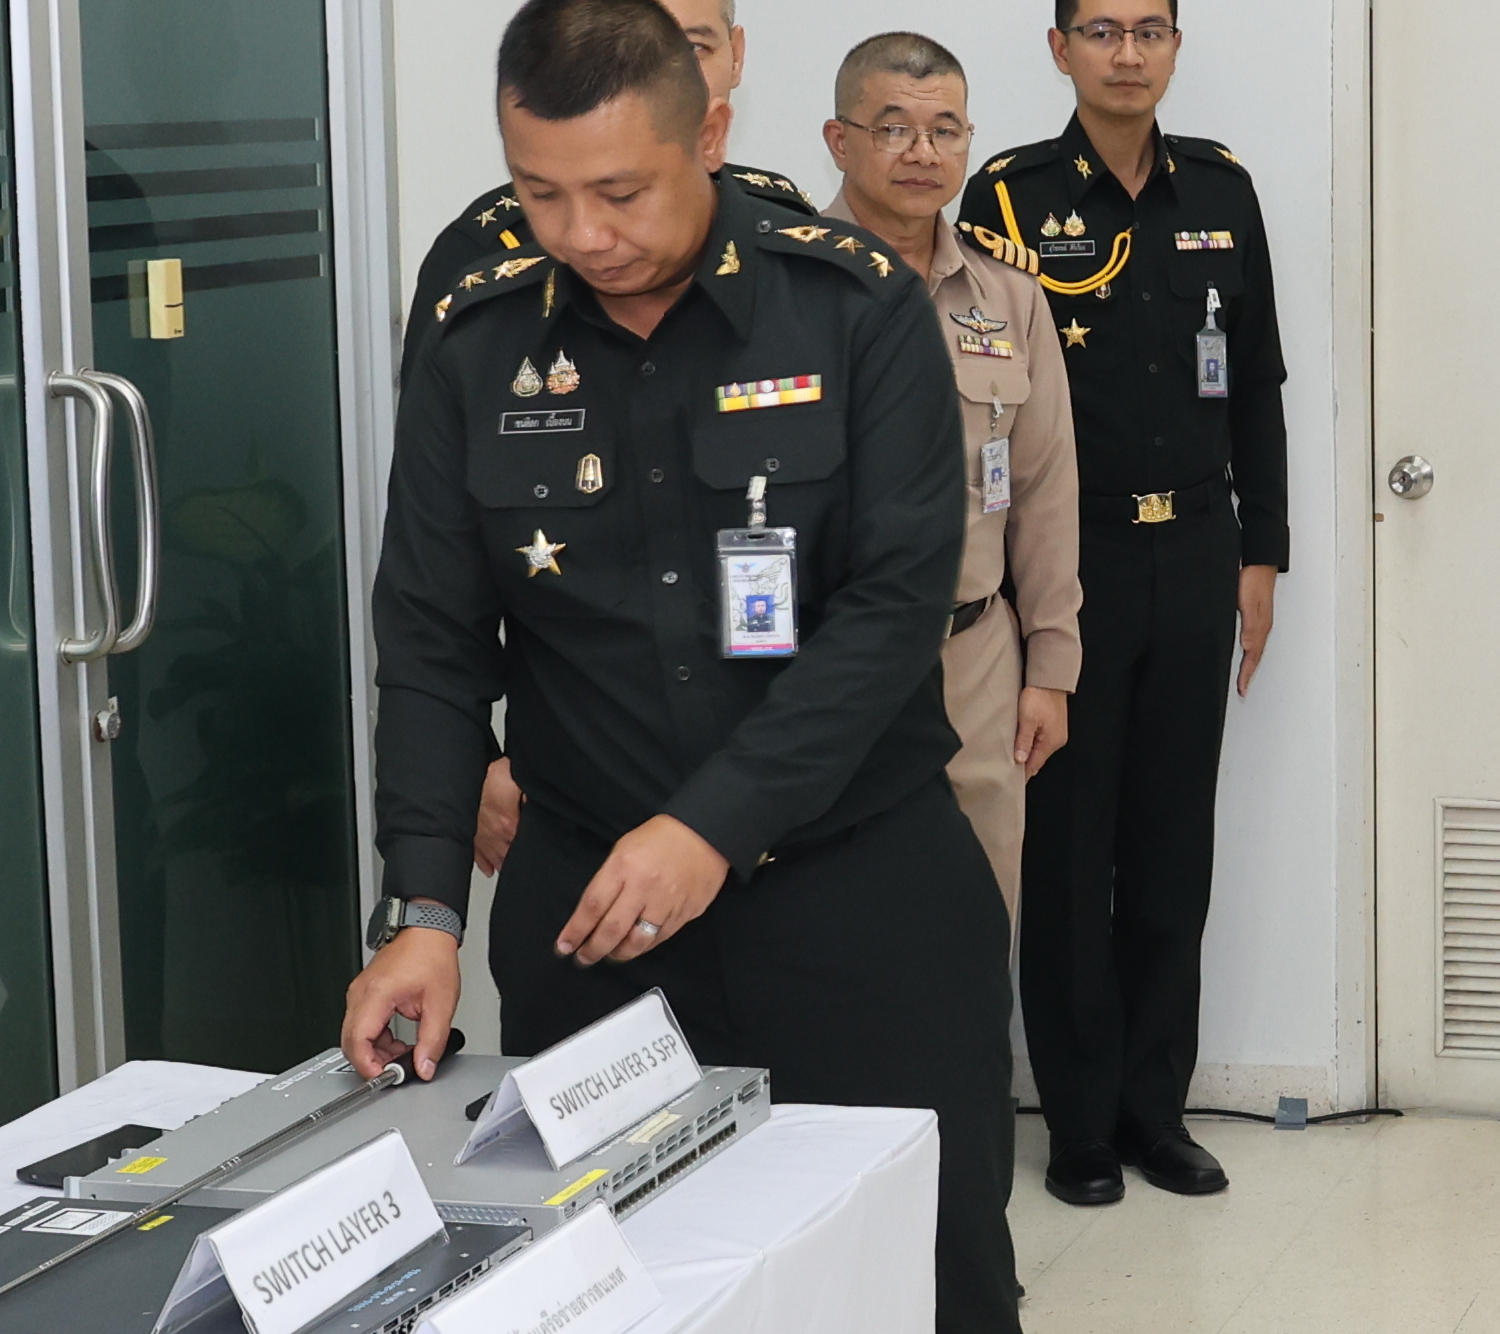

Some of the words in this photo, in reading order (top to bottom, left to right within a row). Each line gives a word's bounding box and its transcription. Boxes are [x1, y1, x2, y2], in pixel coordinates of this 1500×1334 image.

[549, 1071, 610, 1120] SWITCH
[602, 1051, 649, 1090] LAYER
[641, 1046, 658, 1068] 3
[651, 1033, 679, 1062] SFP
[252, 1234, 335, 1305] SWITCH
[327, 1200, 390, 1255] LAYER
[382, 1189, 401, 1219] 3
